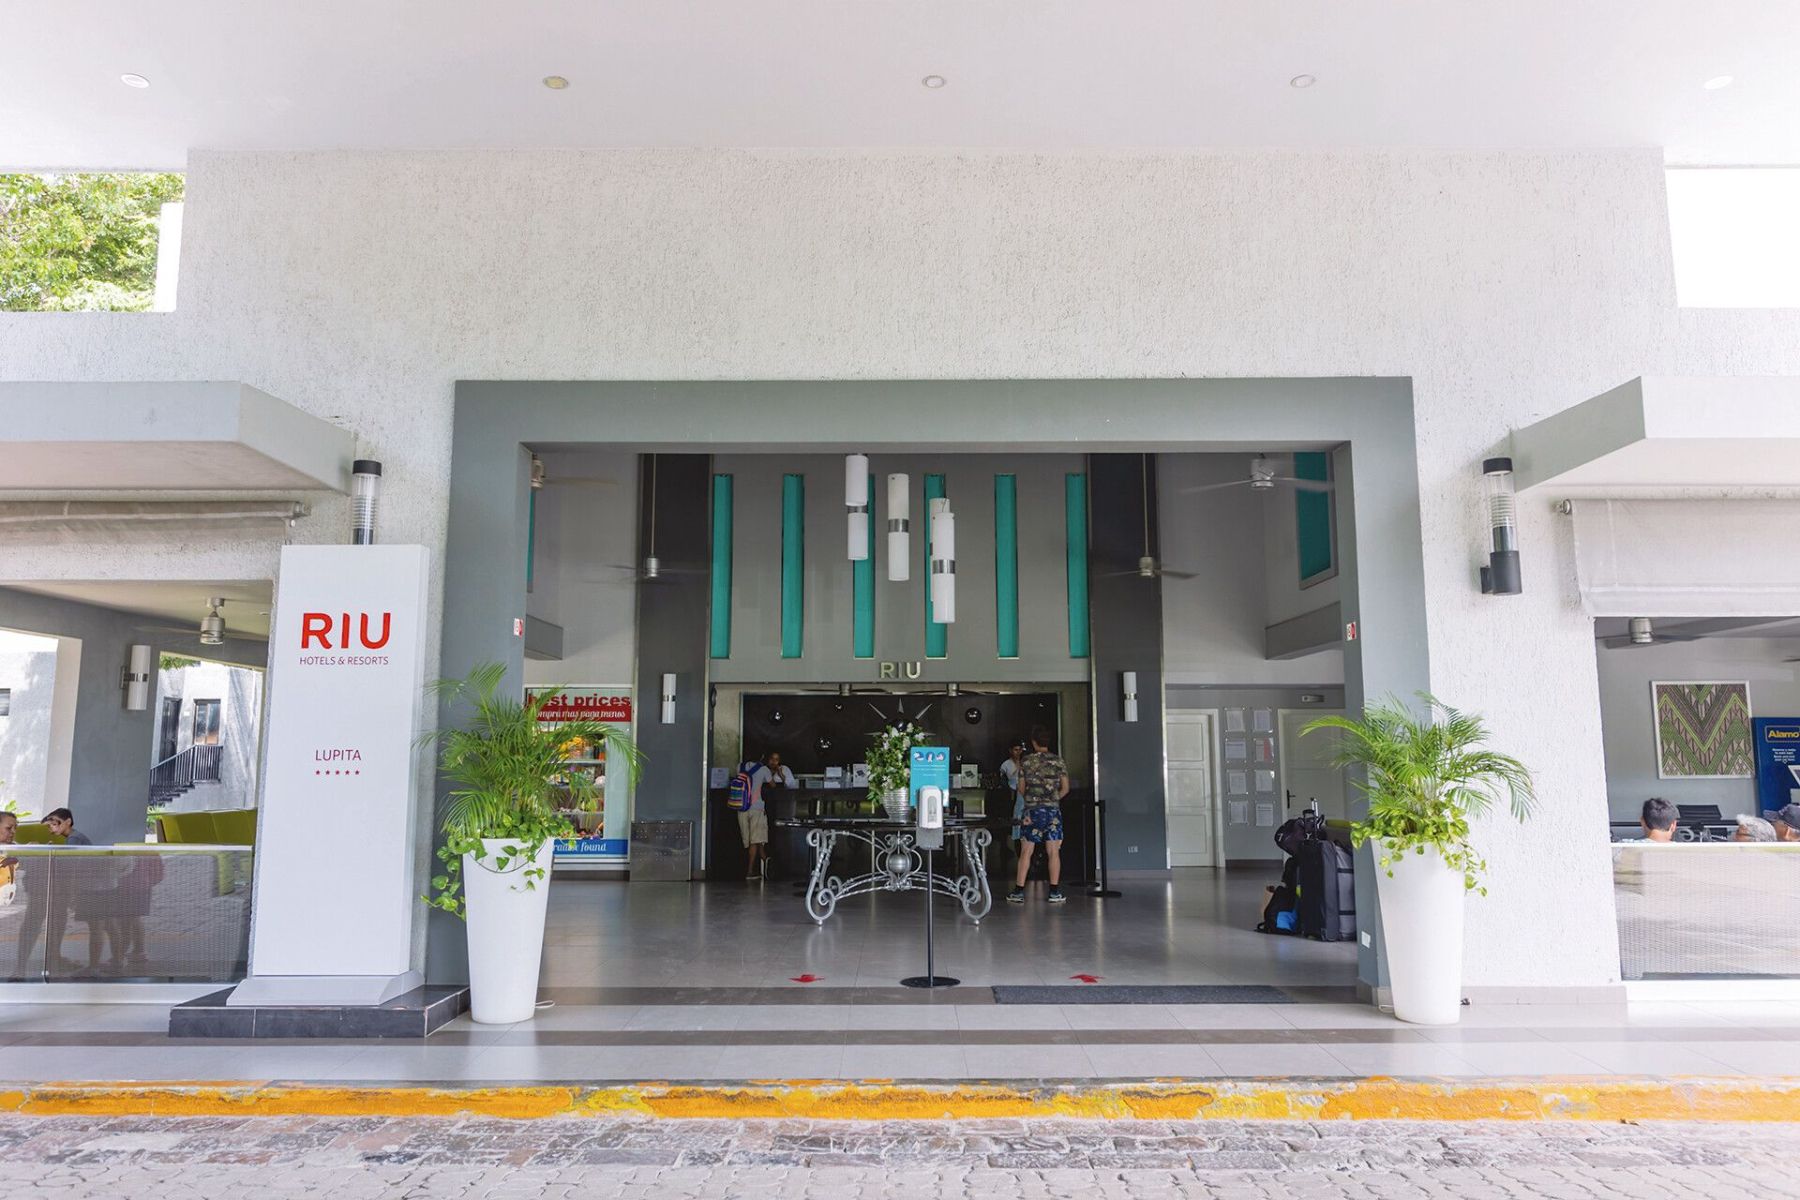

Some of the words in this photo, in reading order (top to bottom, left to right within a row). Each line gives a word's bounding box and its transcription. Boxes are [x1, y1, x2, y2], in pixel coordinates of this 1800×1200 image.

[301, 612, 391, 650] RIU
[299, 656, 336, 665] HOTELS
[337, 656, 345, 665] &
[347, 656, 389, 665] RESORTS
[879, 661, 922, 679] RIU
[528, 693, 568, 706] bst
[574, 693, 631, 706] prices
[1768, 730, 1800, 738] Alamo
[315, 749, 361, 761] LUPITA
[581, 841, 607, 852] found
